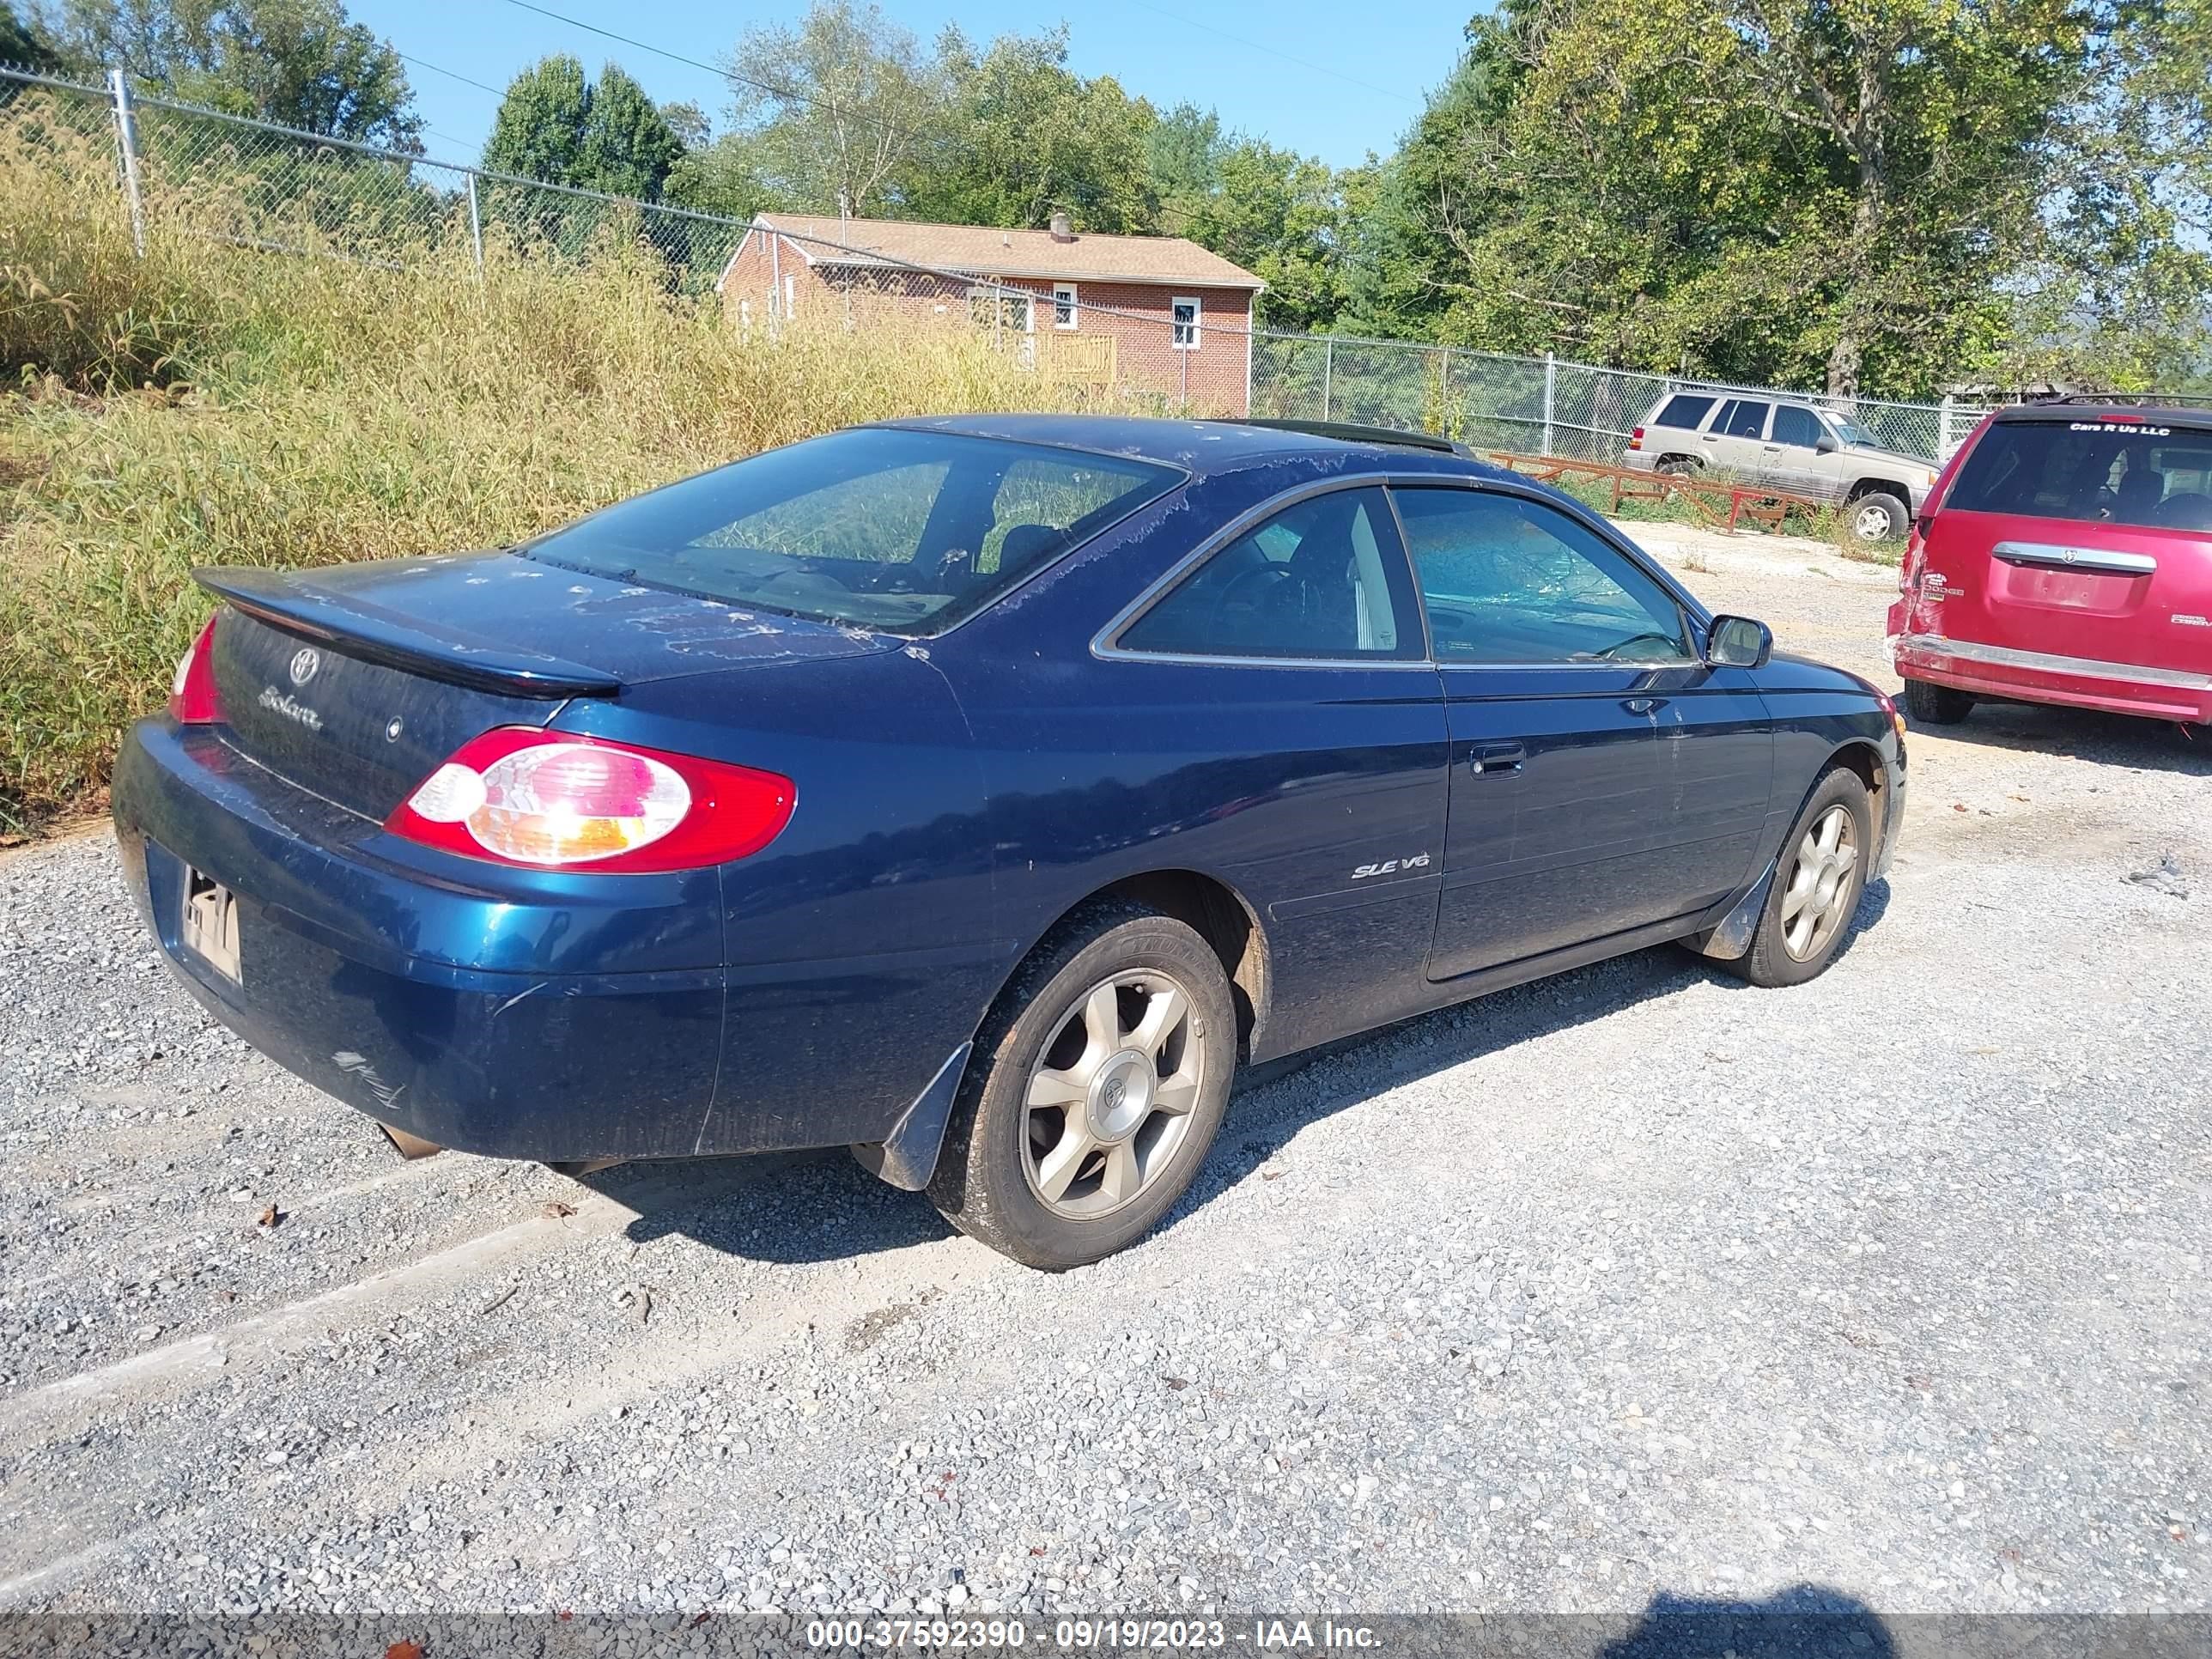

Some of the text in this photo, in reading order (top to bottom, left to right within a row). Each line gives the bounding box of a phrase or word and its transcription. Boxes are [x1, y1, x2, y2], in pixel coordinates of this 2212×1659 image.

[2140, 427, 2171, 436] LLC
[258, 685, 324, 731] Solara
[1351, 854, 1431, 879] SLE V6
